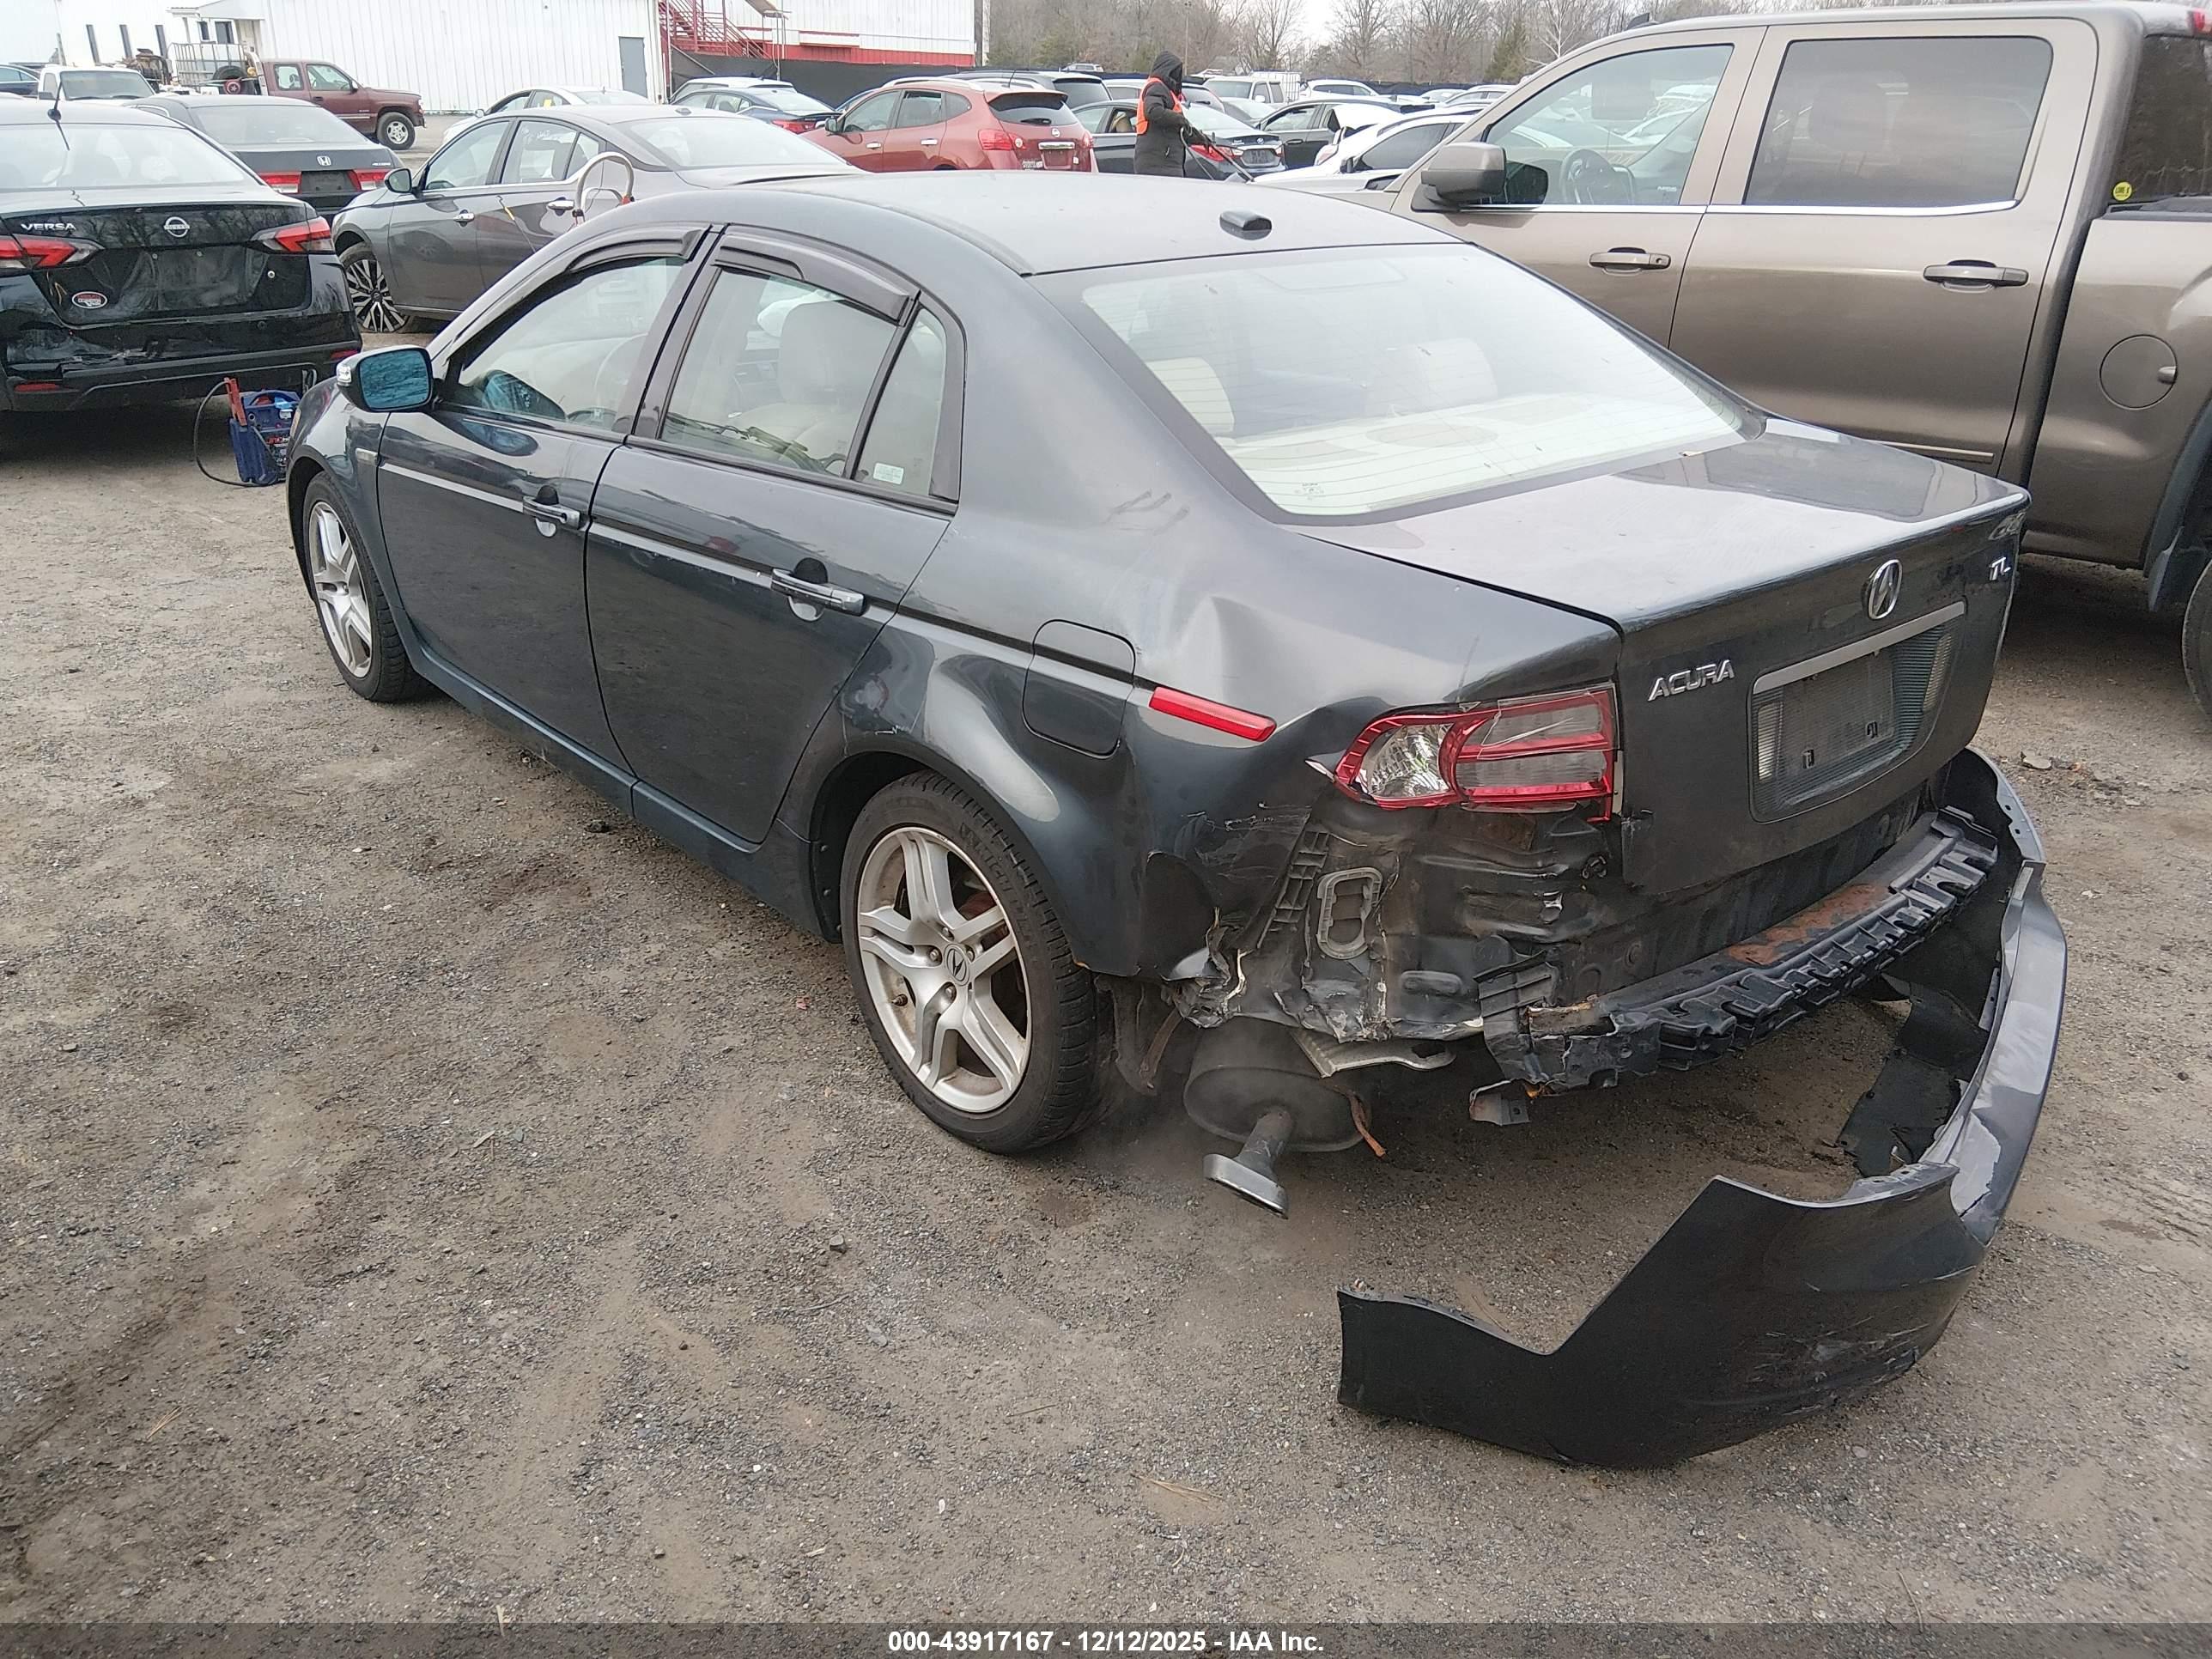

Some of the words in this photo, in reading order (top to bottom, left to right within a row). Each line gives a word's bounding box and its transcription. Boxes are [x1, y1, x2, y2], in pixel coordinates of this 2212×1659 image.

[21, 222, 76, 231] VERSA
[1989, 556, 2011, 580] TL
[1648, 659, 1735, 702] ACURA
